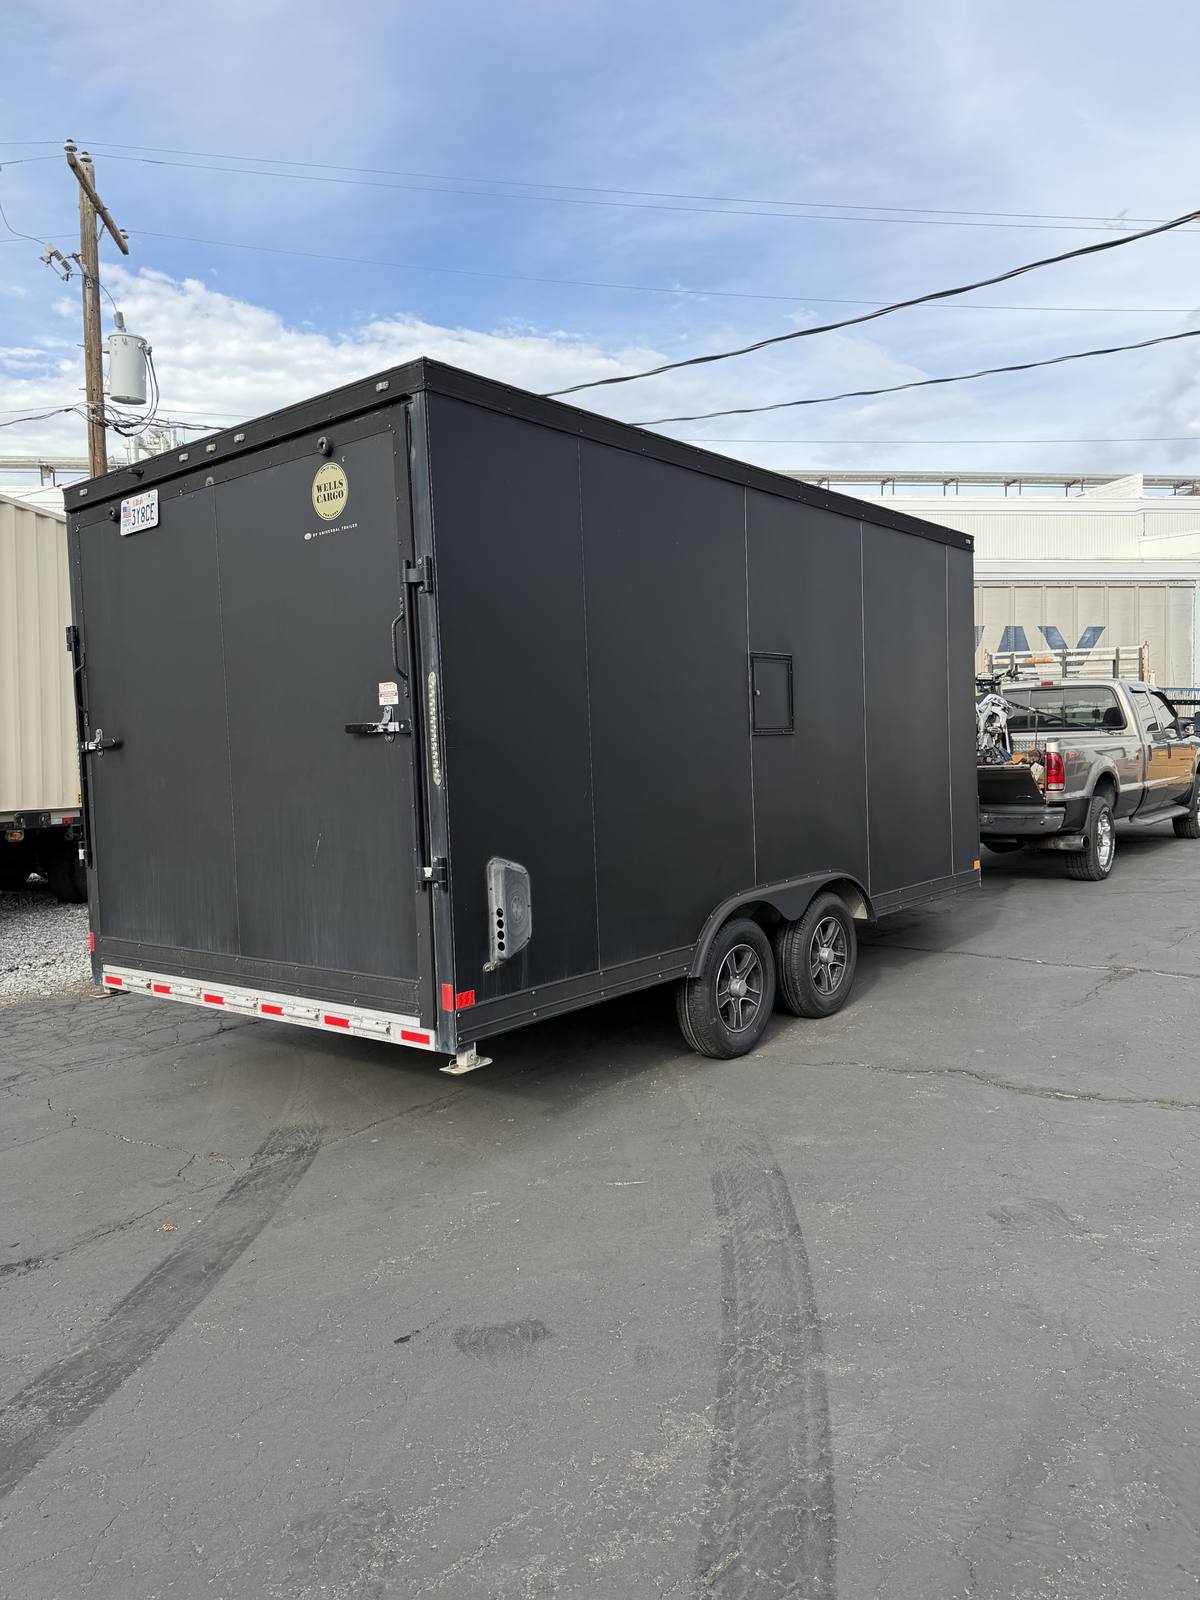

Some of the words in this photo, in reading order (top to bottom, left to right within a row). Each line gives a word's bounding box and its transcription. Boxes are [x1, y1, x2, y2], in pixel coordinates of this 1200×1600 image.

[316, 479, 344, 493] WELLS
[316, 489, 344, 504] CARGO
[131, 503, 154, 526] 3Y8CE
[974, 625, 1106, 679] AY
